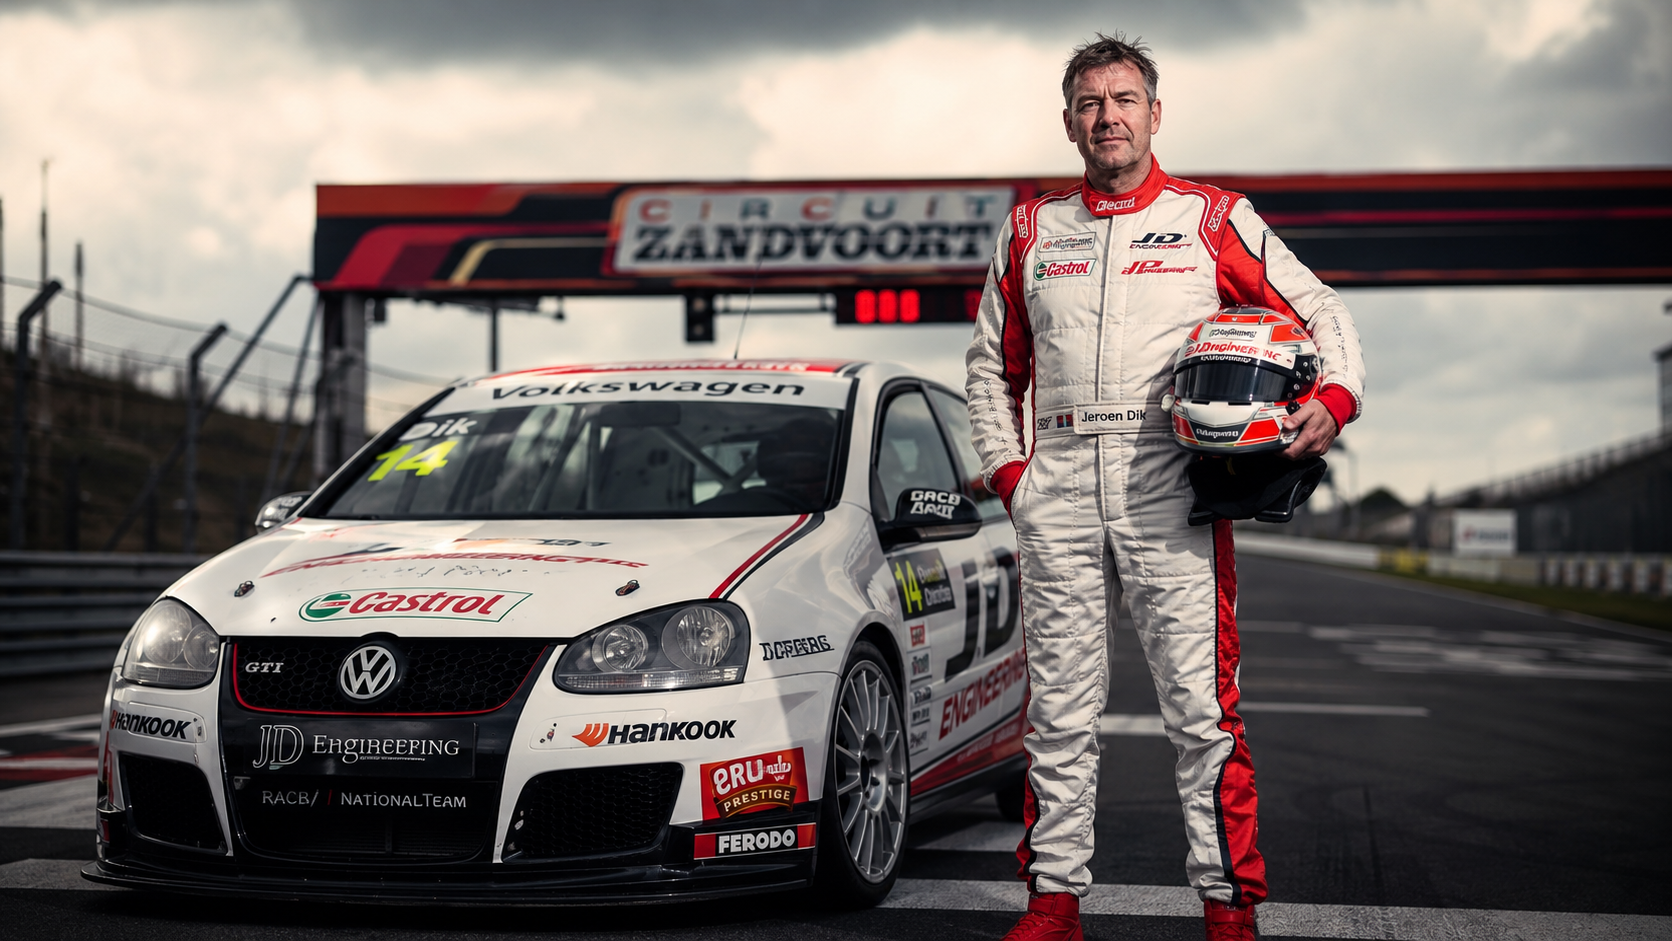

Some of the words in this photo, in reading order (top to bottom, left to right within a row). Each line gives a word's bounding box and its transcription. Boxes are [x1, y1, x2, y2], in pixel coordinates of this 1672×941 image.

[639, 196, 995, 222] CIRCUIT
[633, 221, 992, 262] ZANDVOORT
[1047, 261, 1090, 276] Castrol
[491, 379, 805, 400] Volkswagen
[1081, 411, 1123, 422] Jeroen
[1127, 410, 1147, 421] Dik
[400, 416, 477, 440] Dik
[368, 440, 458, 481] 14
[895, 560, 922, 614] 14
[349, 592, 506, 615] Castrol
[245, 662, 284, 673] GTI
[723, 789, 790, 812] PRESTIGE
[718, 829, 795, 853] FERODO
